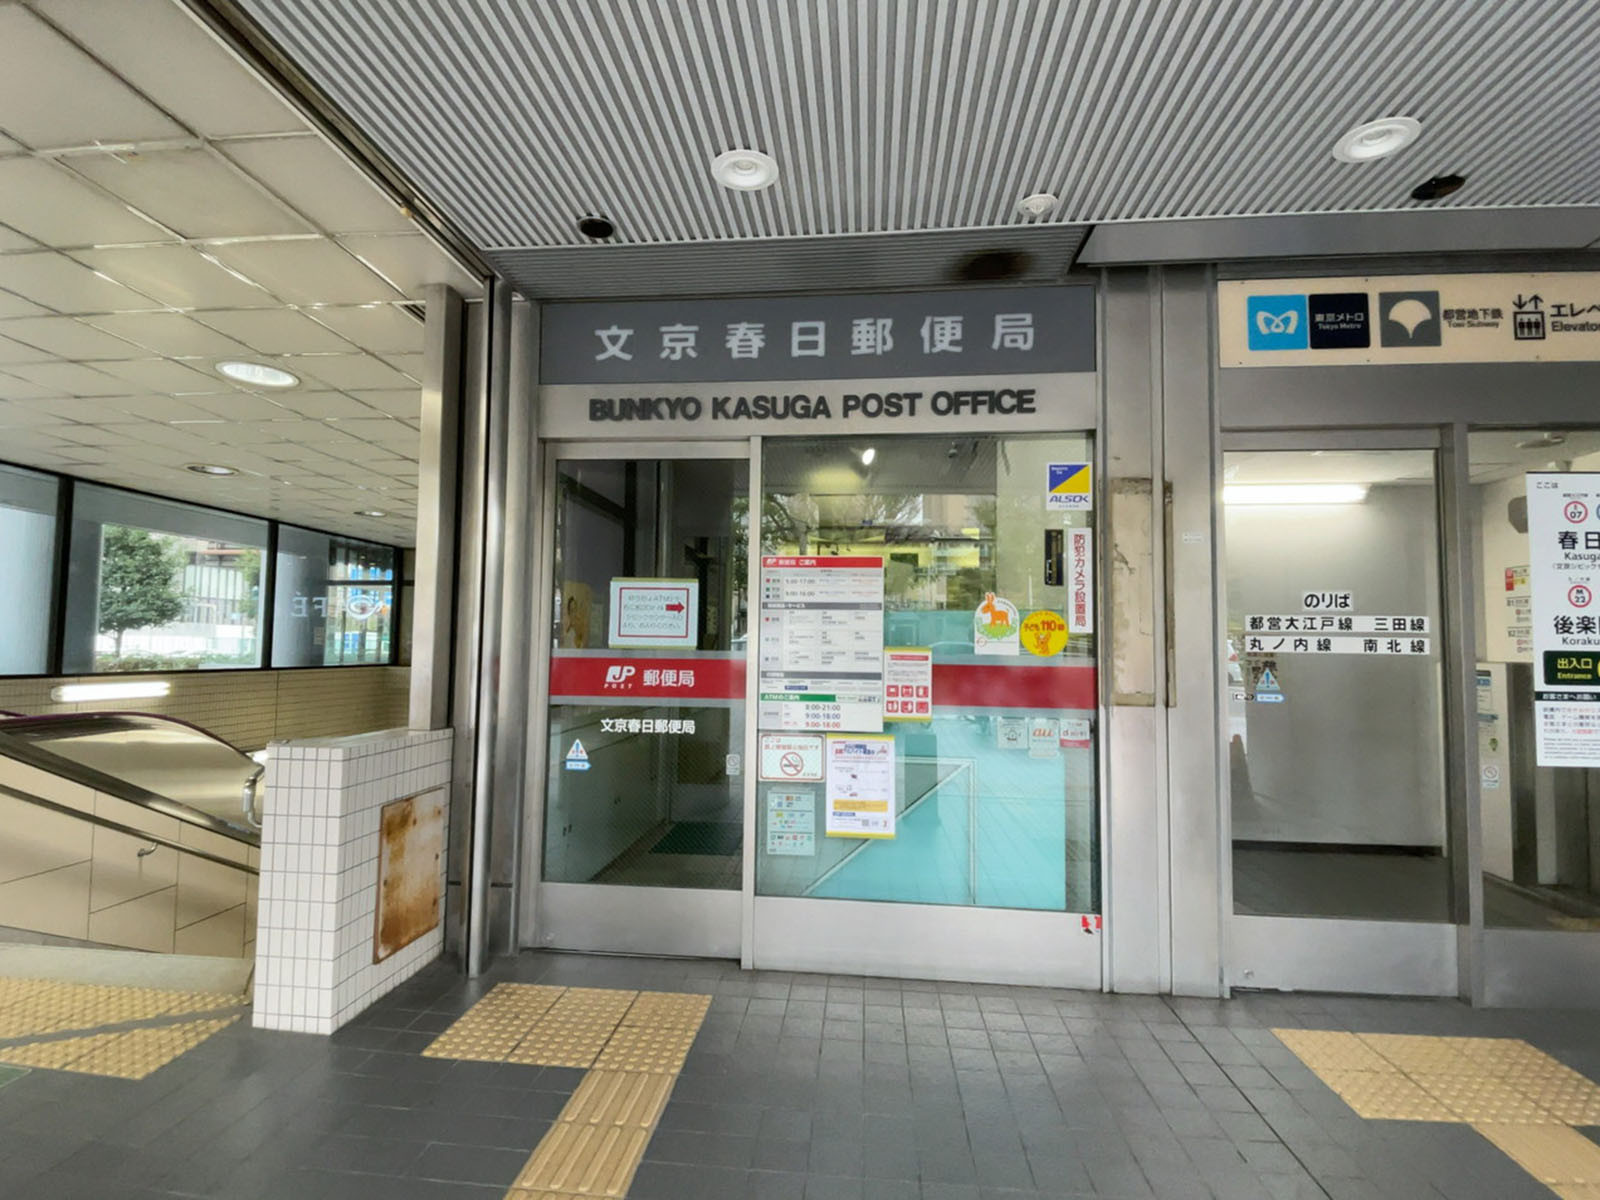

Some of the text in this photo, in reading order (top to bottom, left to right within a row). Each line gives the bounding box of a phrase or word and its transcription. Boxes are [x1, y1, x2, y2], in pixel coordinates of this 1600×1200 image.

[1315, 312, 1364, 321] 東京メトロ
[1443, 308, 1503, 320] 都営地下鉄
[594, 313, 1035, 361] 文京春日郵便局
[589, 389, 1036, 422] BUNKYO KASUGA POST OFFICE
[1049, 495, 1089, 503] ALSOK
[1569, 511, 1583, 519] 07
[1558, 531, 1600, 550] 春日
[1073, 534, 1087, 627] 防犯カメラ設置局
[1304, 593, 1350, 608] のりば
[1250, 616, 1425, 632] 都営大江戸線 三田線
[1553, 615, 1600, 635] 後楽
[1250, 637, 1425, 653] 丸ノ内線 南北線
[1557, 657, 1593, 670] 出入口
[643, 669, 696, 688] 郵便局
[600, 718, 697, 735] 文京春日郵便局
